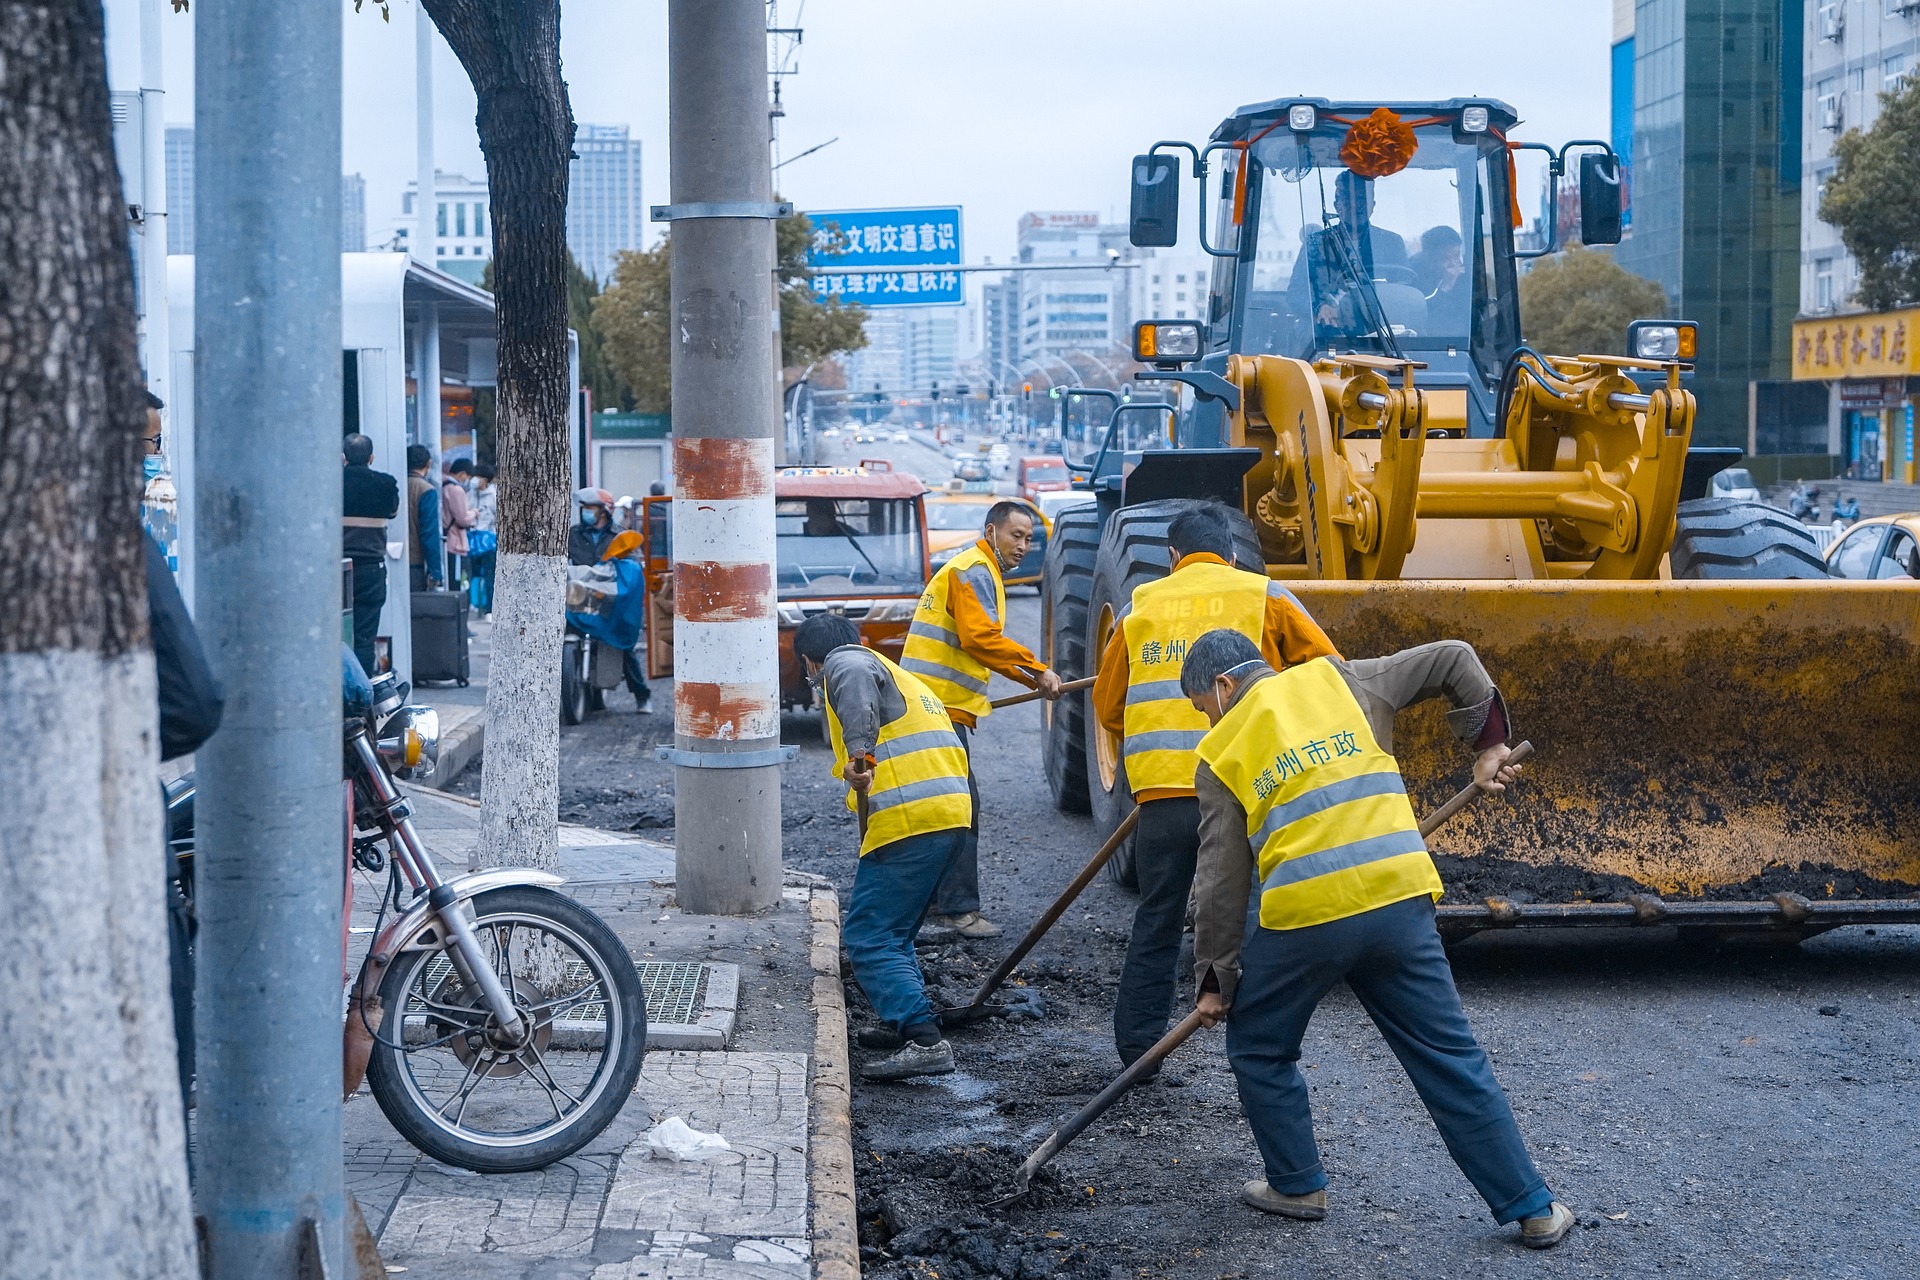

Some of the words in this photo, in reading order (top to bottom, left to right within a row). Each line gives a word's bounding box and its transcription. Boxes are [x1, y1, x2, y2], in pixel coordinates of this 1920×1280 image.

[1164, 597, 1224, 618] HEAD
[1141, 639, 1196, 666] 赣州
[1252, 730, 1363, 801] 赣州市政
